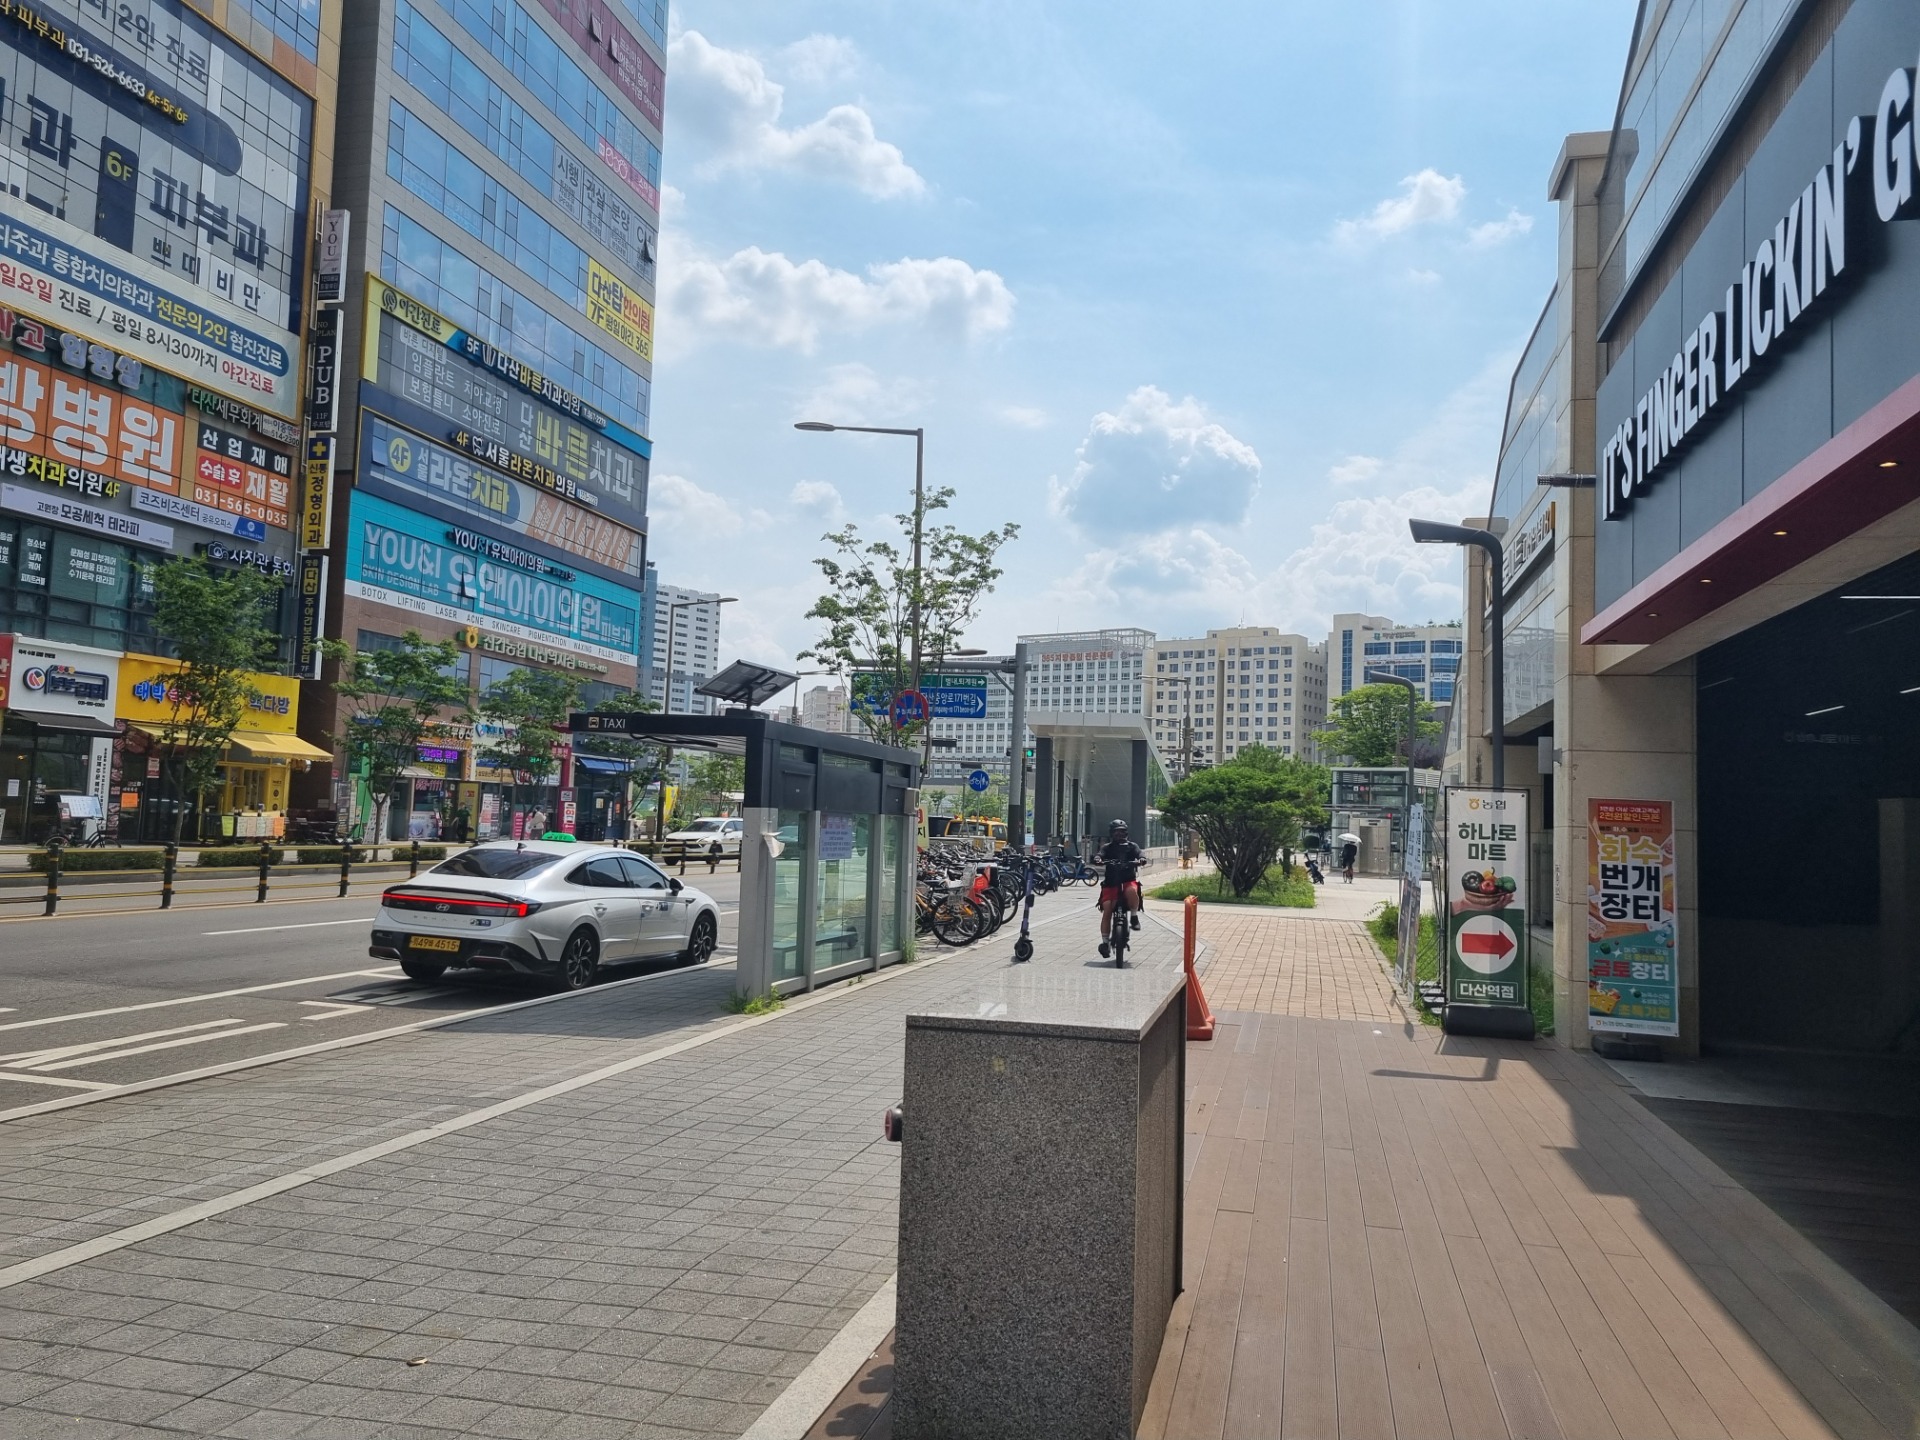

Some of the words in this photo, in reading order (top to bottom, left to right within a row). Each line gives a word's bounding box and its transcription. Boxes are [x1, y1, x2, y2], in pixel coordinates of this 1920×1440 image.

[66, 38, 146, 98] 031-526-6633
[165, 33, 207, 86] 진료
[105, 151, 133, 182] 6F
[149, 166, 270, 272] 피부과
[327, 221, 339, 257] YOU
[1635, 311, 1718, 486] FINGER
[1873, 50, 1920, 222] G
[51, 246, 155, 314] 통합치의학과
[157, 295, 203, 336] 전문의
[204, 318, 228, 348] 2인
[216, 268, 262, 313] 비만
[0, 261, 54, 305] 일요일
[58, 288, 92, 319] 진료
[111, 310, 142, 342] 평일
[222, 359, 275, 395] 야간진료
[316, 329, 337, 338] PLAN
[317, 321, 329, 329] NO
[590, 300, 604, 327] 7F
[635, 335, 649, 357] 365
[466, 336, 480, 355] 5F
[315, 346, 333, 405] PUB
[411, 351, 455, 389] 임플란트
[202, 428, 288, 475] 산업재해
[390, 443, 410, 467] 4F
[456, 430, 469, 447] 4F
[535, 409, 635, 502] 바른치과
[105, 480, 121, 499] 4F
[246, 471, 289, 508] 재활
[428, 451, 511, 515] 라온치과
[60, 502, 105, 530] 모공세척
[107, 519, 141, 538] 테라피
[194, 487, 288, 526] 031-565-0035
[307, 475, 325, 546] 정형외과
[452, 527, 490, 556] YOU&I
[491, 541, 546, 574] 유앤아이의원
[362, 563, 384, 583] SKIN
[386, 570, 421, 592] DESIGN
[421, 580, 440, 597] LAB
[365, 523, 442, 579] YOU&I
[446, 553, 602, 642] 유앤아이의원
[361, 586, 388, 601] BOTOX
[397, 595, 426, 612] LIFTING
[435, 604, 458, 619] LASER
[466, 613, 484, 626] ACNE
[491, 620, 521, 636] SKINCARE
[528, 629, 567, 648] PIGMENTATION
[573, 641, 592, 654] WAXING
[602, 717, 627, 730] TAXI
[1481, 799, 1507, 811] 농협
[1457, 822, 1518, 843] 하나로
[1600, 834, 1661, 865] 화수
[1467, 843, 1507, 861] 마트
[1600, 863, 1661, 893] 번개
[1600, 892, 1661, 922] 장터
[1459, 982, 1515, 1000] 다산역점
